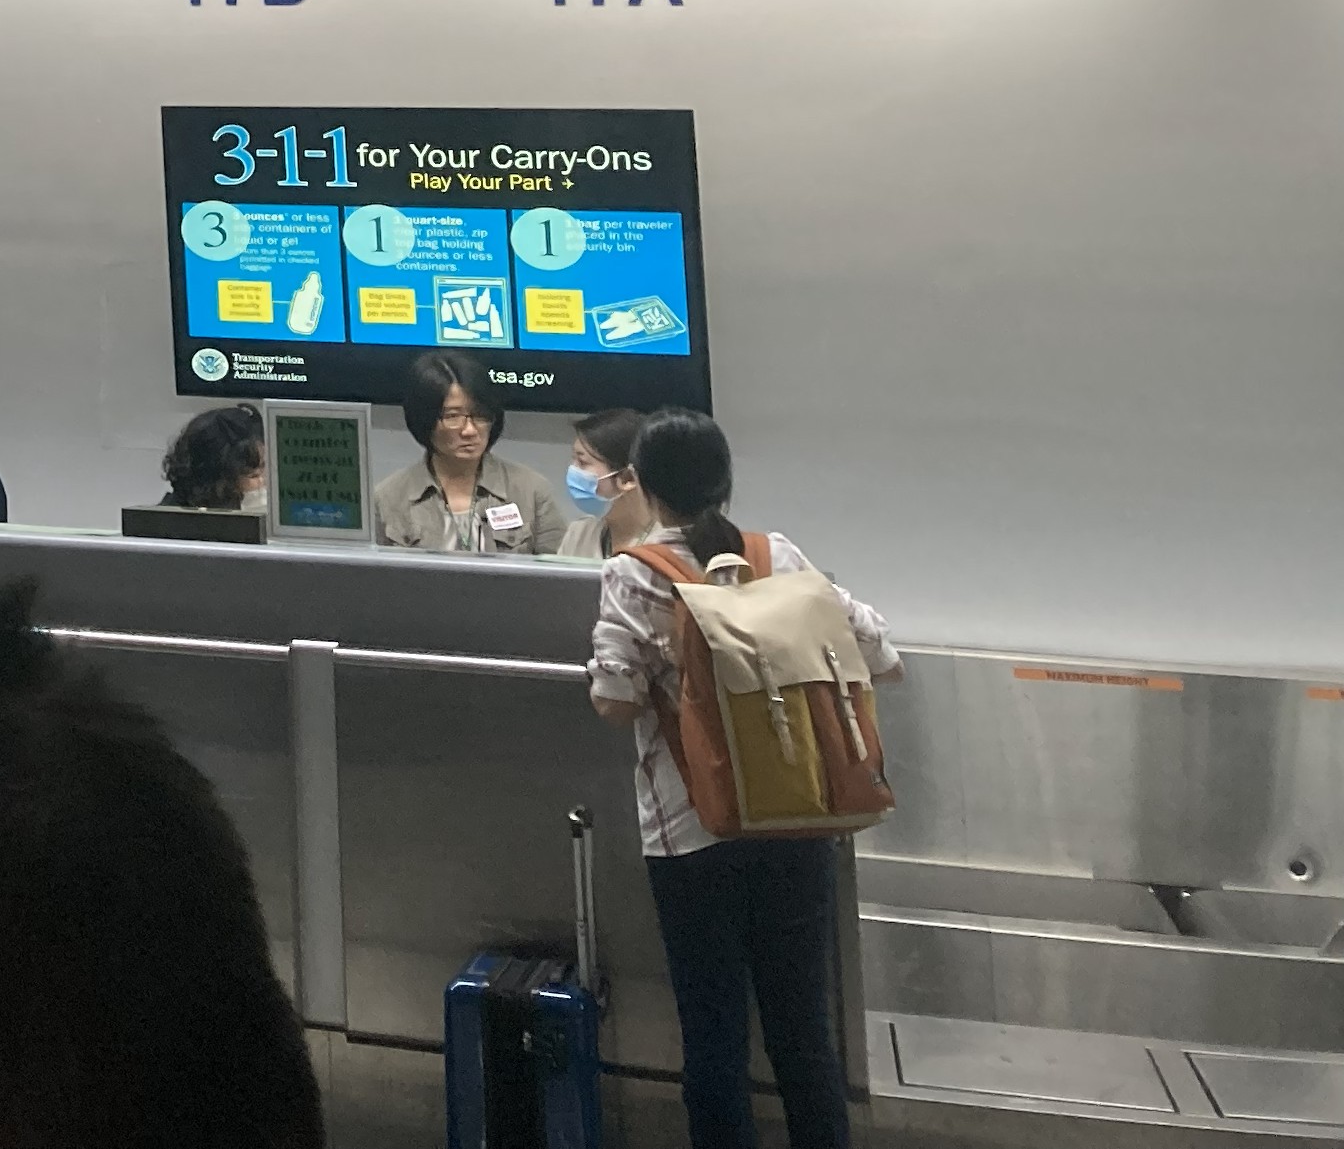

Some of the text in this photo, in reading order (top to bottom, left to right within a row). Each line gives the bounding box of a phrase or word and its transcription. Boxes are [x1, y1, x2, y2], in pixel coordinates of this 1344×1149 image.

[212, 123, 652, 188] 3-1-1 for Your Carry-Ons
[410, 173, 553, 192] Play Your Part
[307, 213, 330, 222] less
[202, 212, 227, 248] 3
[258, 224, 317, 234] containers
[321, 225, 333, 234] of
[577, 219, 600, 230] bag
[604, 220, 624, 230] per
[627, 220, 673, 230] traveler
[368, 216, 388, 253] 1
[471, 229, 488, 238] zip
[540, 220, 559, 257] 1
[610, 232, 644, 241] in the
[281, 237, 299, 247] gel
[417, 240, 485, 250] bag holding
[616, 243, 636, 252] bin
[409, 252, 449, 260] ounces
[468, 252, 493, 261] less
[232, 353, 305, 365] Transportation
[233, 362, 275, 373] Security
[233, 370, 308, 383] Administration
[487, 368, 555, 387] tsa.gov
